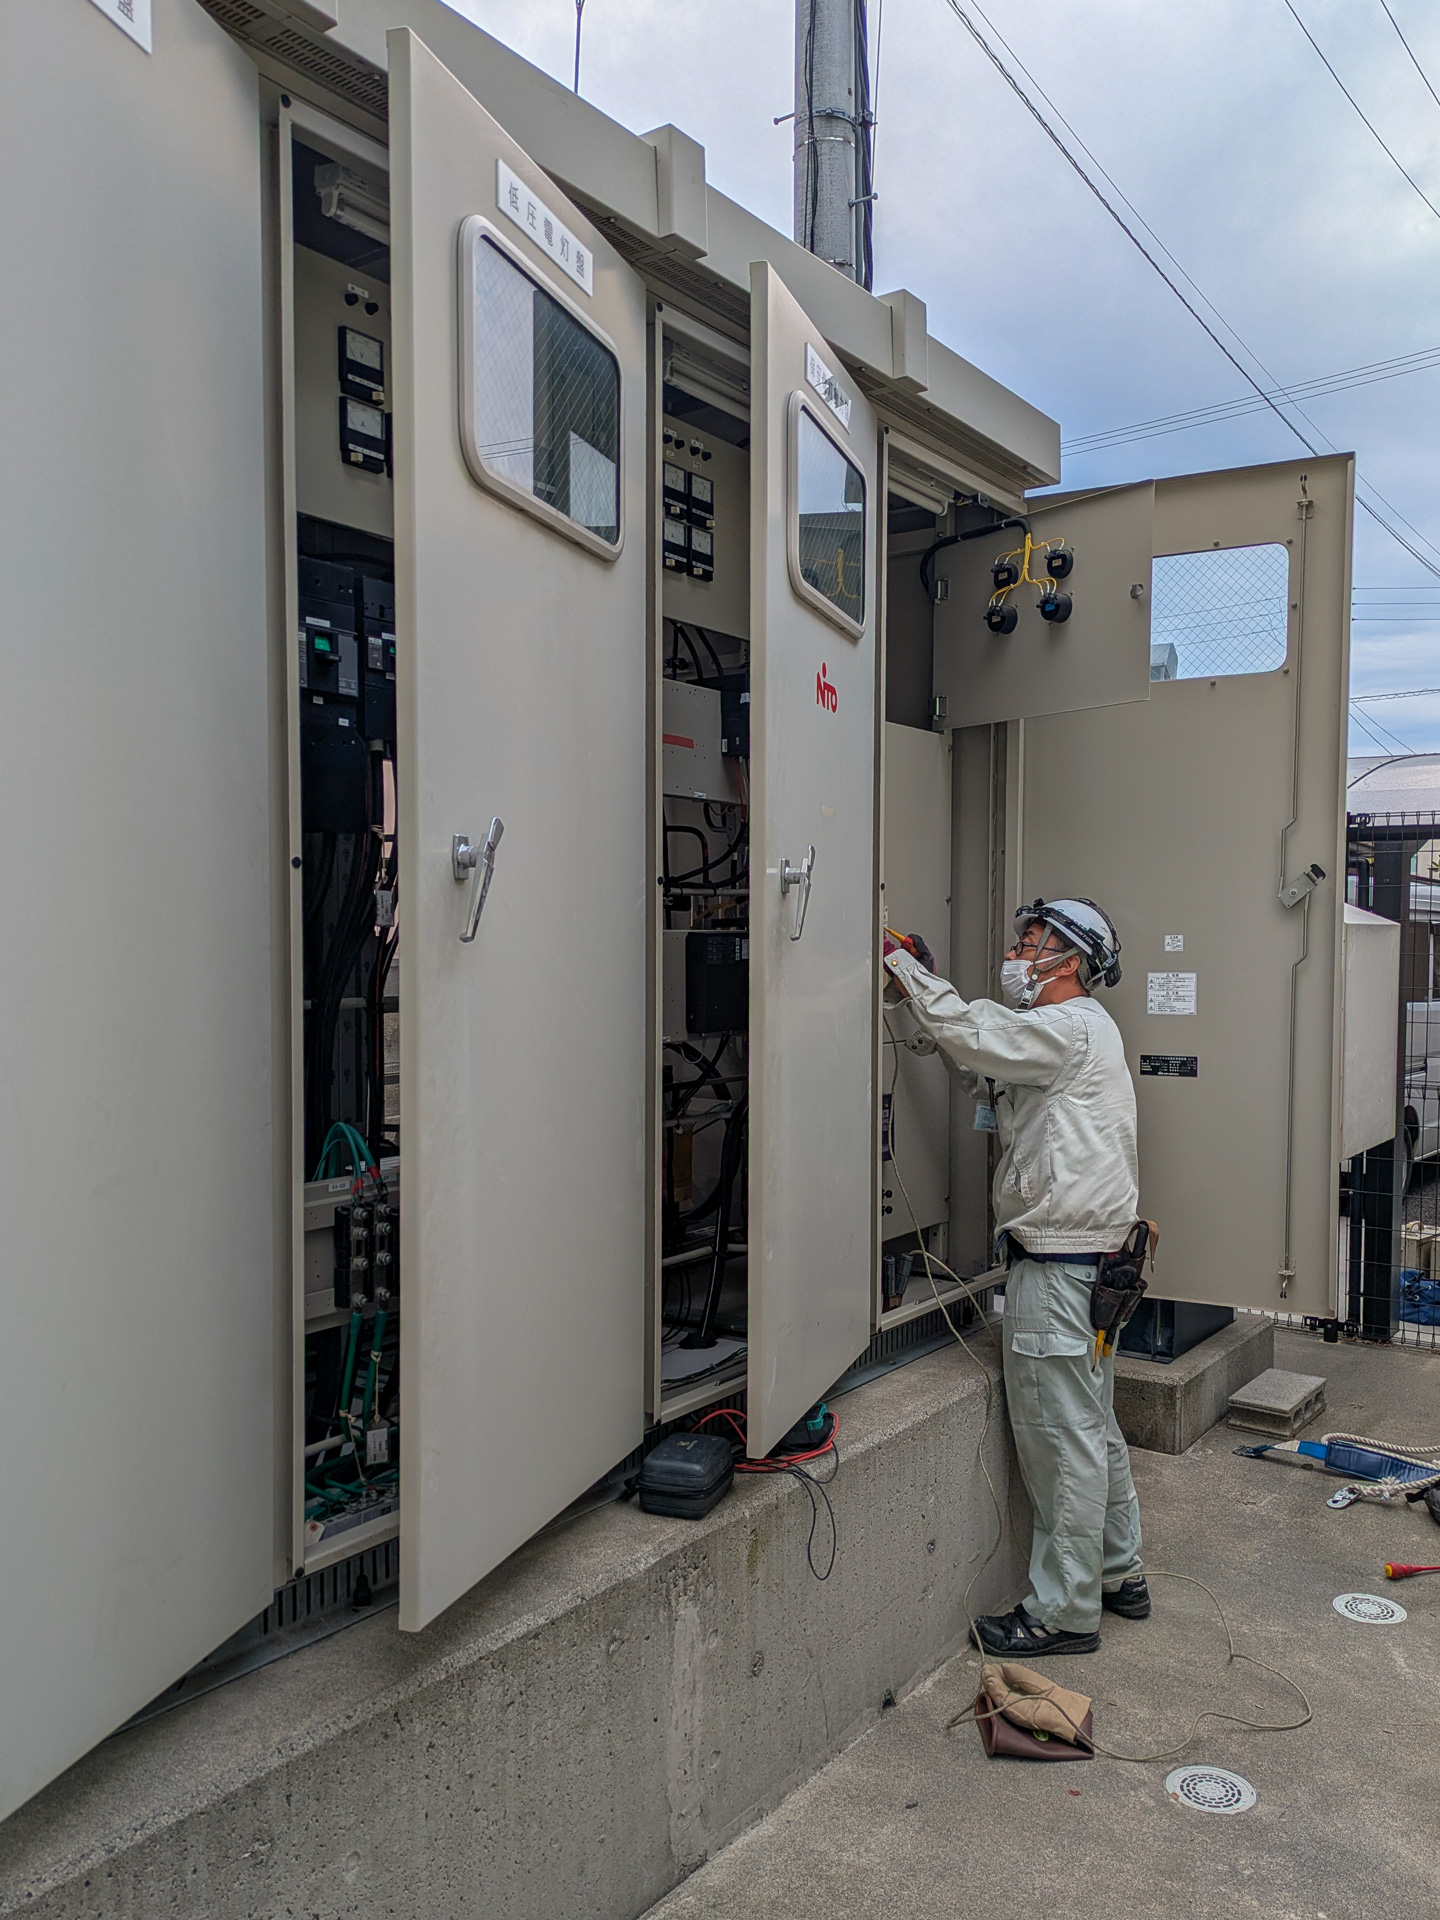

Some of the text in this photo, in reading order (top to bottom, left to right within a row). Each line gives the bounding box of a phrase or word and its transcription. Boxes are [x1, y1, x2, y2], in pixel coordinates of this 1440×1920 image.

[508, 182, 585, 279] 低圧電灯盤
